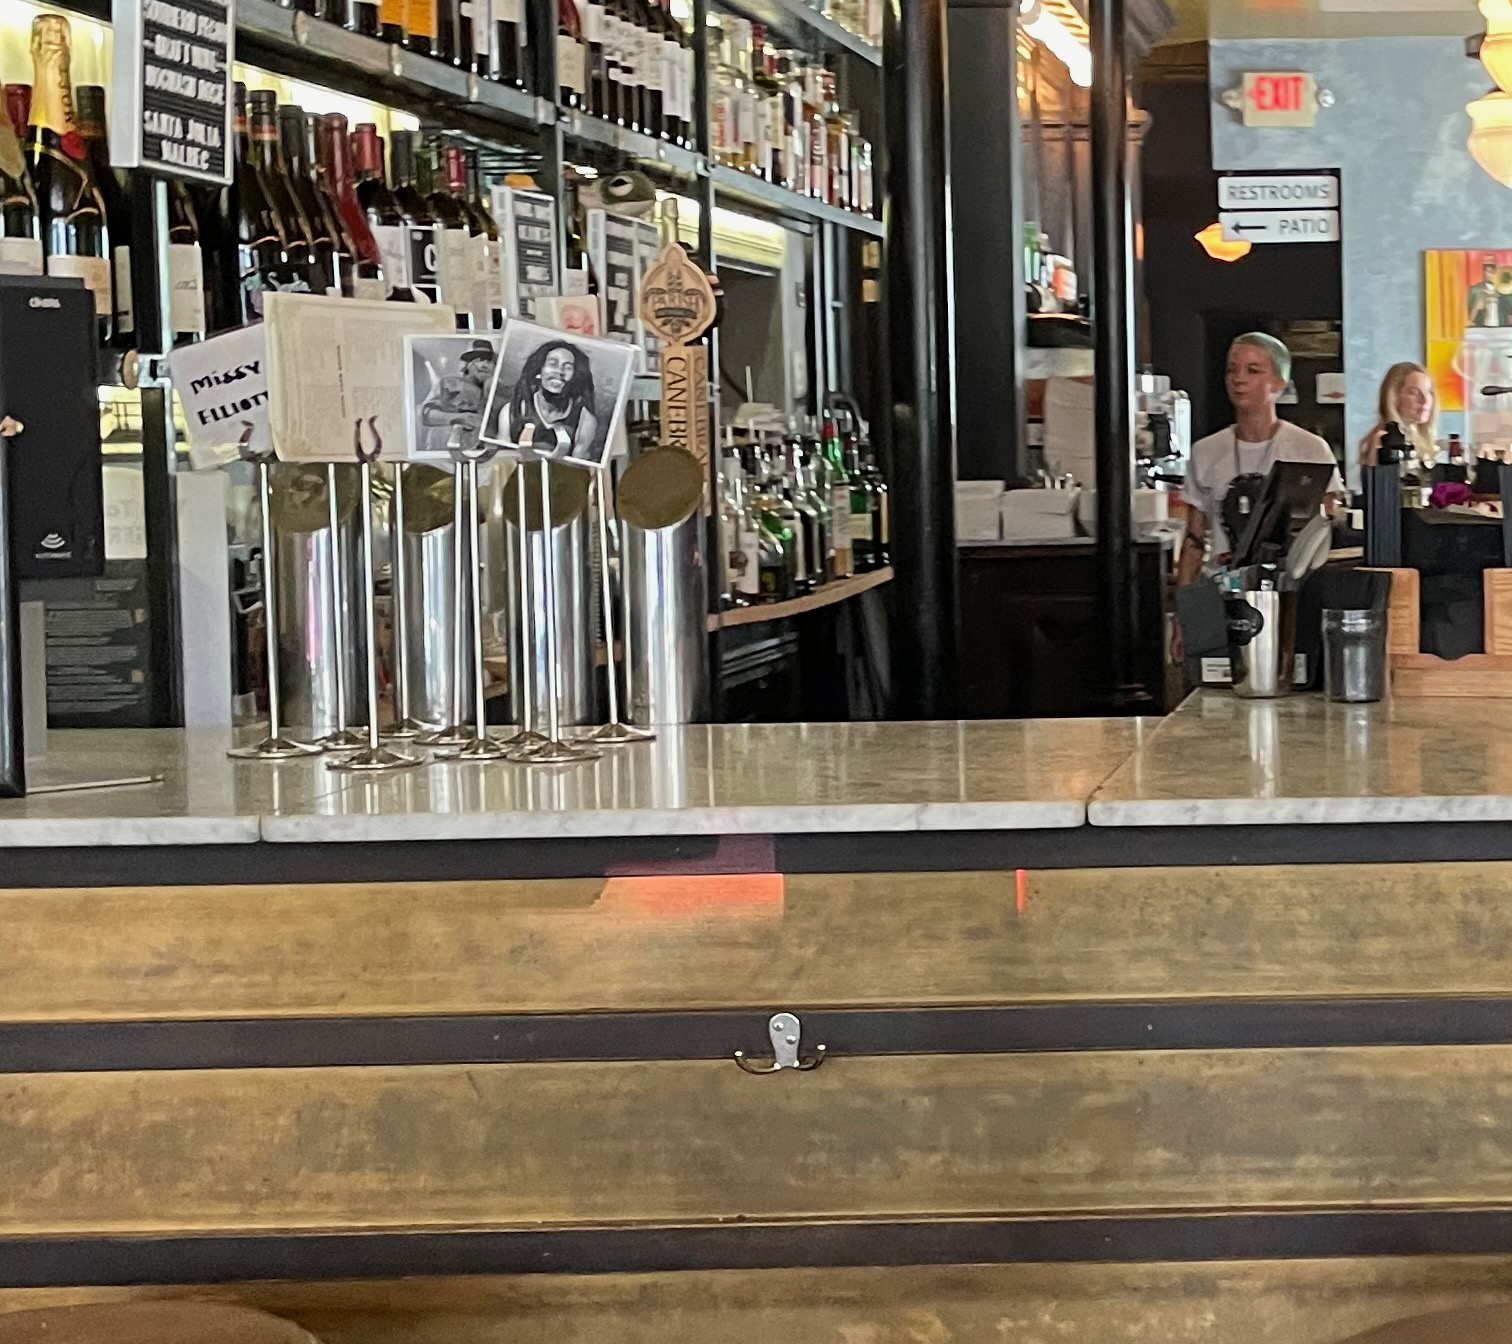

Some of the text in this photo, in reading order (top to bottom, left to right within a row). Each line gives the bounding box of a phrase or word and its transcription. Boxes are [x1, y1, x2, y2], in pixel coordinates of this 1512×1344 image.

[1256, 76, 1303, 111] EXIT
[1227, 184, 1330, 200] RESTROOMS
[1279, 218, 1329, 234] PATIO
